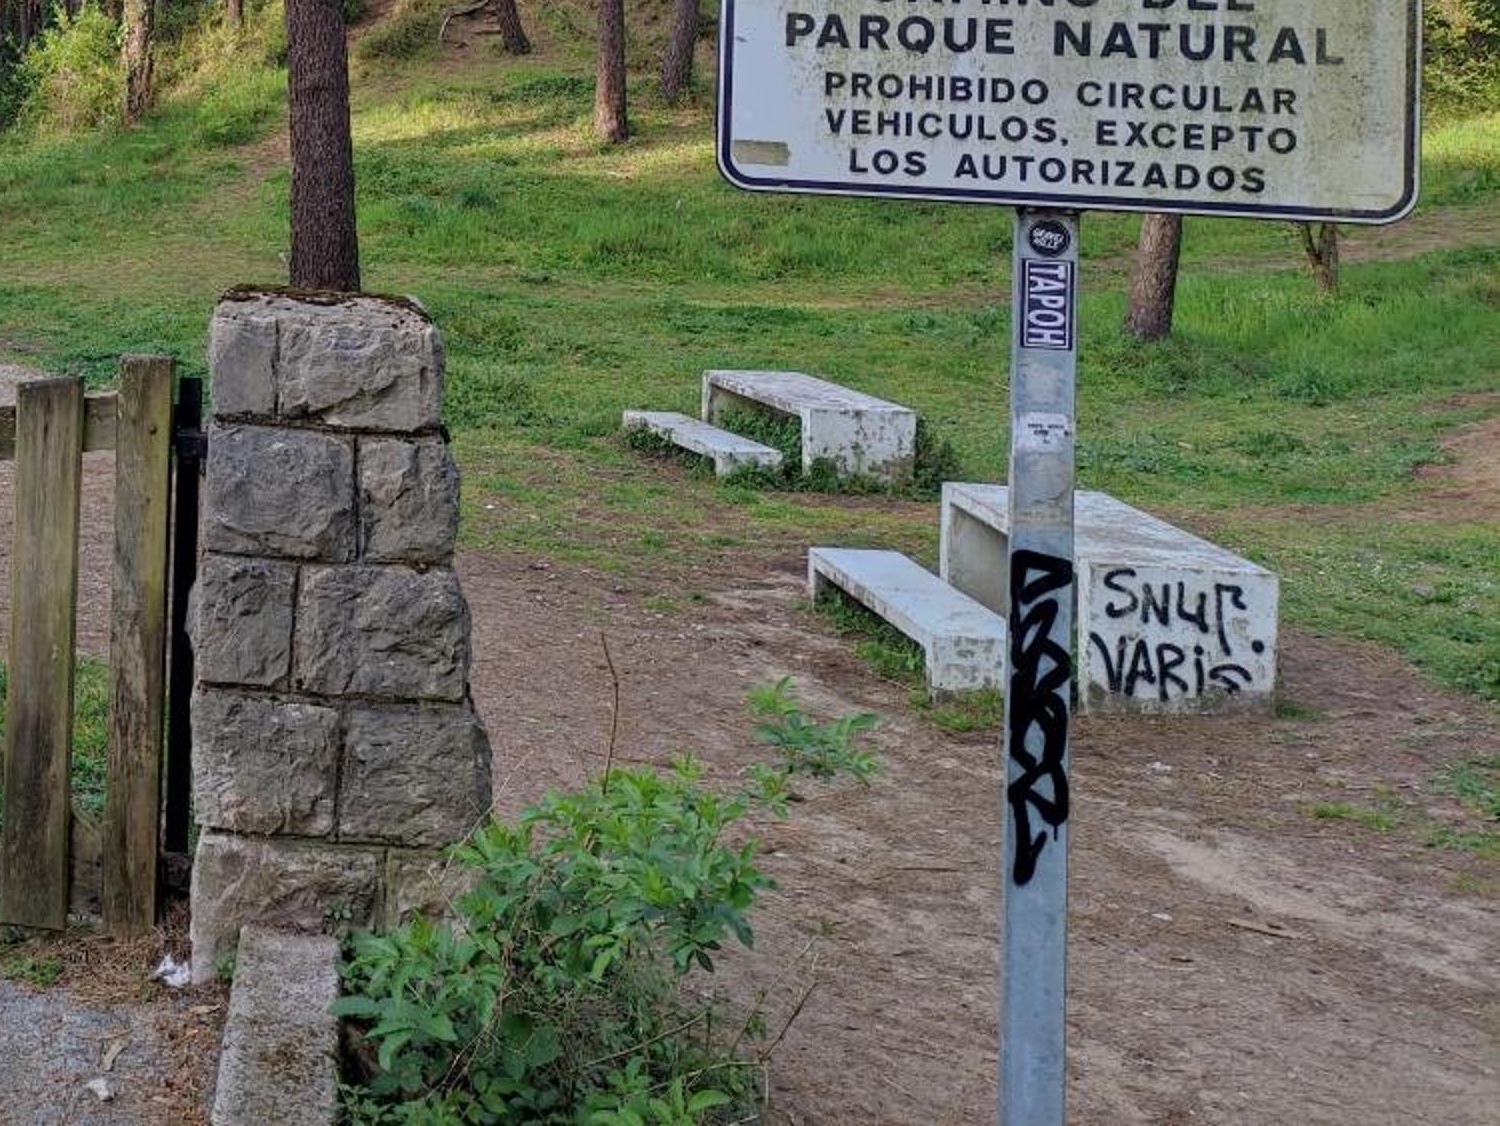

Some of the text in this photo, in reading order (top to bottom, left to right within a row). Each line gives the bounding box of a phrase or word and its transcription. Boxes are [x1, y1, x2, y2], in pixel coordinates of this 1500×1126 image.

[785, 12, 1344, 65] PARQUE NATURAL
[825, 72, 1297, 115] PROHIBIDO CIRCULAR
[1095, 120, 1297, 155] EXCEPTO
[849, 148, 1266, 193] LOS AUTORIZADOS
[1028, 265, 1066, 345] TAPOH
